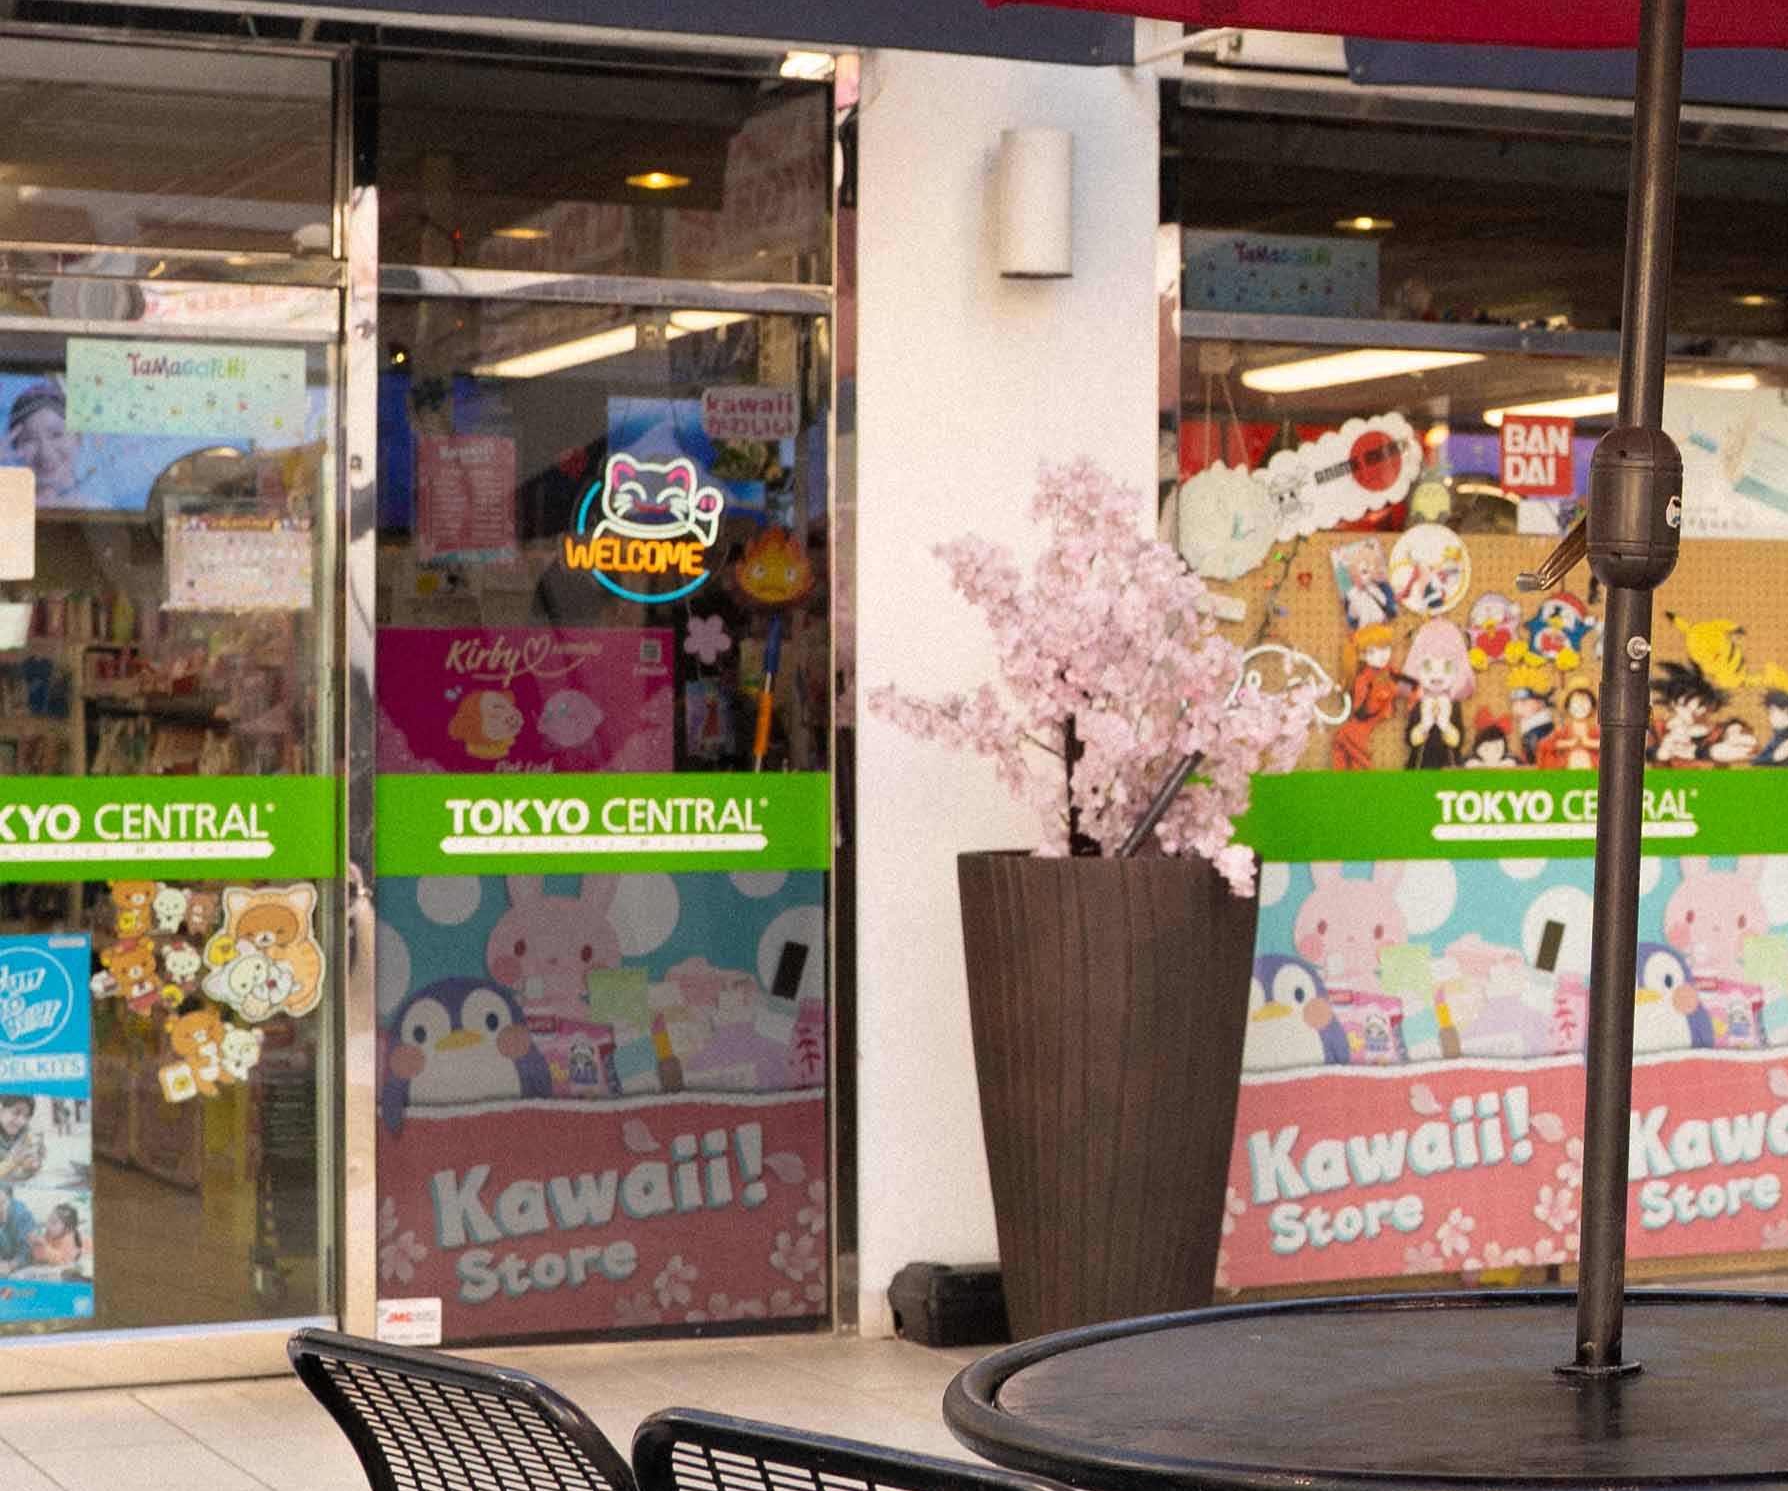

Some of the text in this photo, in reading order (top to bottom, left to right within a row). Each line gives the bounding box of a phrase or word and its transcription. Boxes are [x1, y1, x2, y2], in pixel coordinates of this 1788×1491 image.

[707, 392, 794, 413] kawaii
[1504, 422, 1569, 456] BAN
[1504, 455, 1558, 486] DAI
[565, 536, 706, 576] WELCOME
[446, 634, 521, 688] Kirby
[94, 803, 269, 840] CENTRAL
[445, 797, 763, 834] TOKYO CENTRAL
[1436, 789, 1694, 822] TOKYO CERAL
[1246, 1086, 1534, 1204] Kawaii!
[431, 1124, 769, 1249] Kawaii!
[1638, 1172, 1782, 1230] Store
[1268, 1192, 1425, 1255] Store
[456, 1239, 638, 1305] Store
